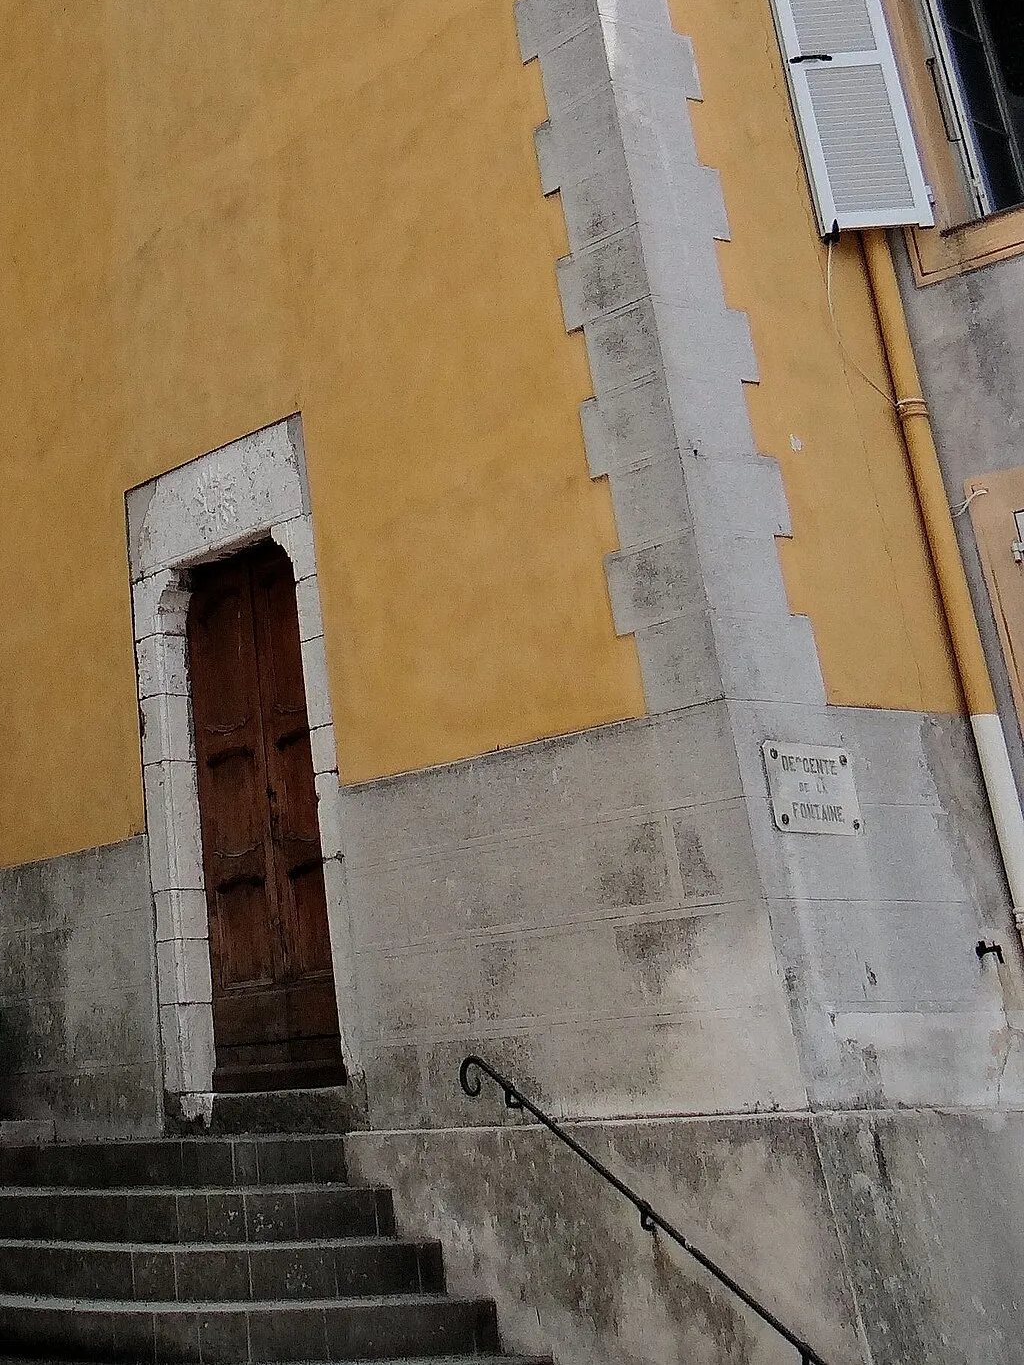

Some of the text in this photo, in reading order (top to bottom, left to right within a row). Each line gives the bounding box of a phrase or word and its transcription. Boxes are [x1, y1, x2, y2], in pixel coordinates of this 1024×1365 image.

[798, 779, 828, 794] DE LA
[791, 802, 845, 823] FONTAINE
